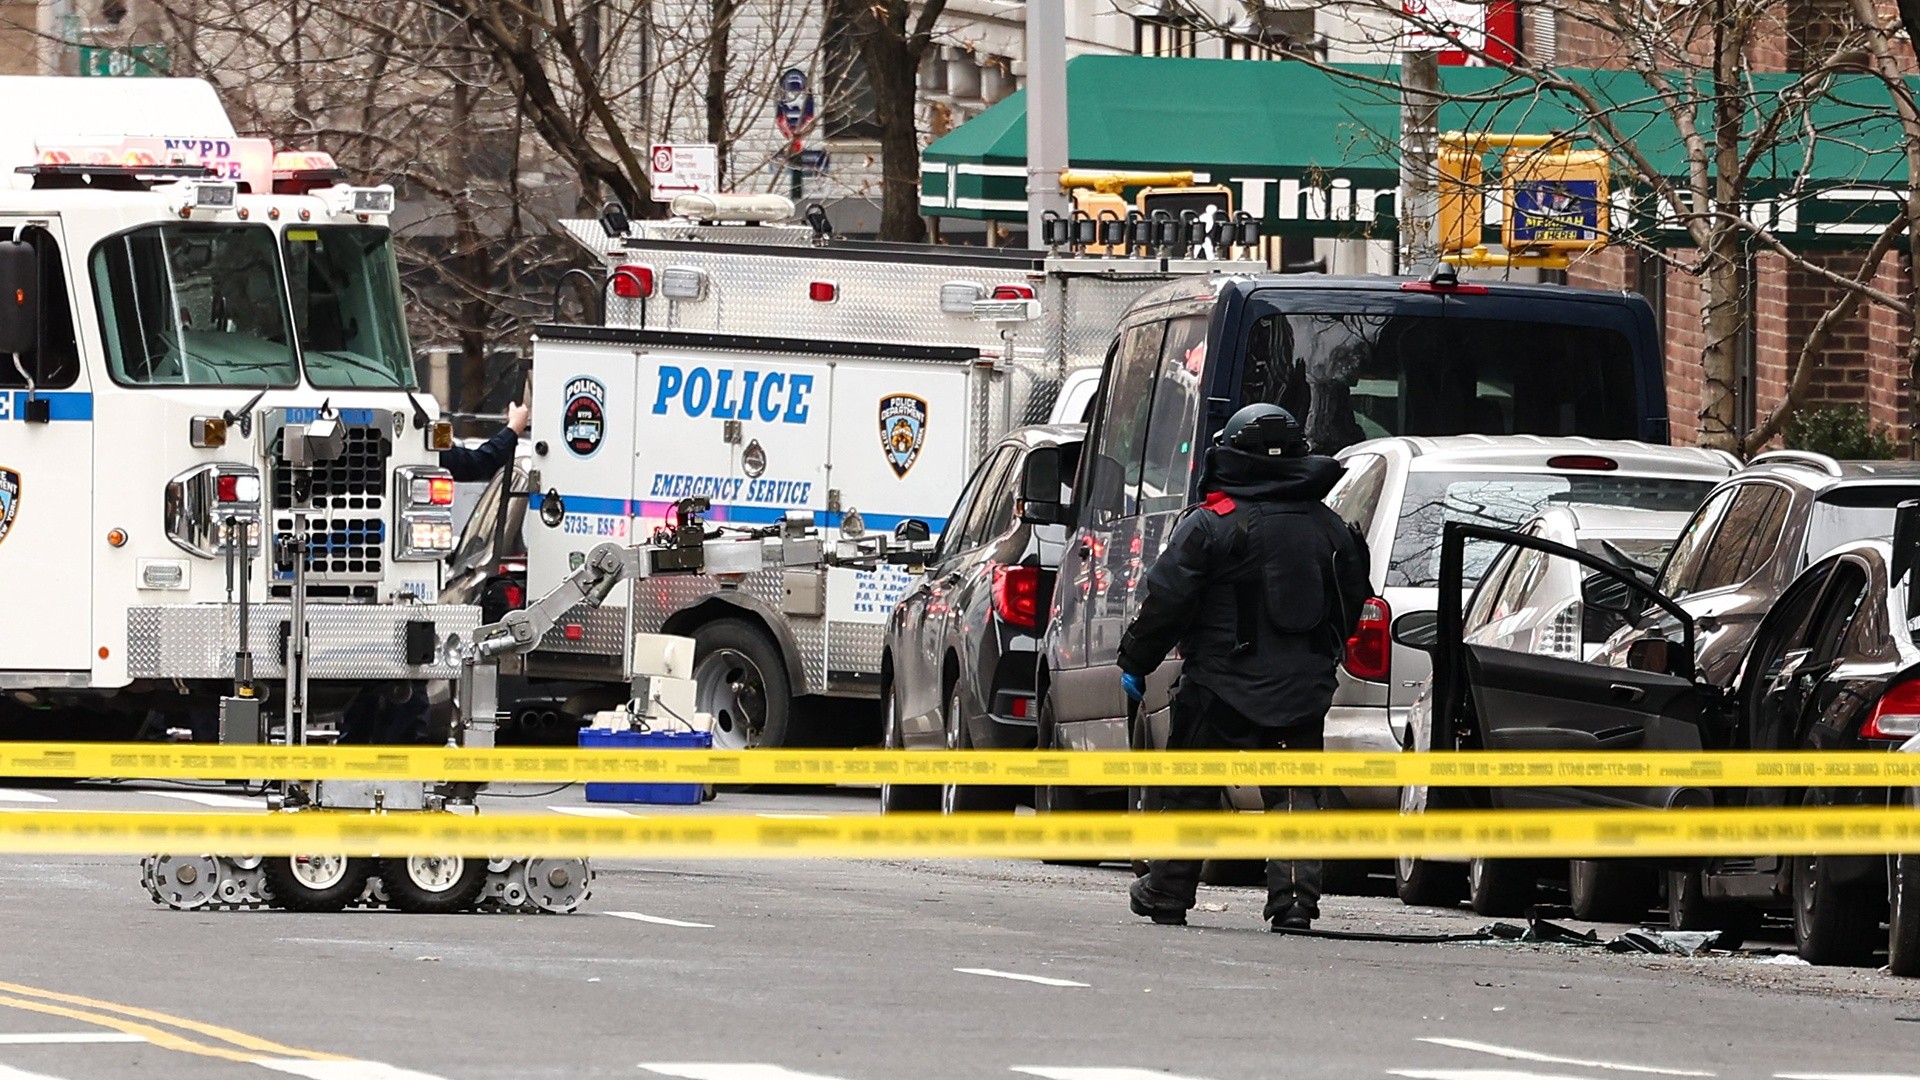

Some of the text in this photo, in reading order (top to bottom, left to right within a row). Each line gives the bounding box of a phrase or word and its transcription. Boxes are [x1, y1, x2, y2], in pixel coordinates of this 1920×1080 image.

[566, 380, 604, 403] POLICE
[652, 365, 814, 424] POLICE
[890, 398, 917, 408] POLICE
[881, 407, 925, 423] DEPARTMENT
[650, 473, 812, 505] EMERGENCY SERVICE
[6, 498, 18, 522] YORK
[564, 515, 588, 535] 5735
[597, 517, 616, 536] ESS
[619, 518, 626, 537] 2
[854, 603, 873, 613] ESS
